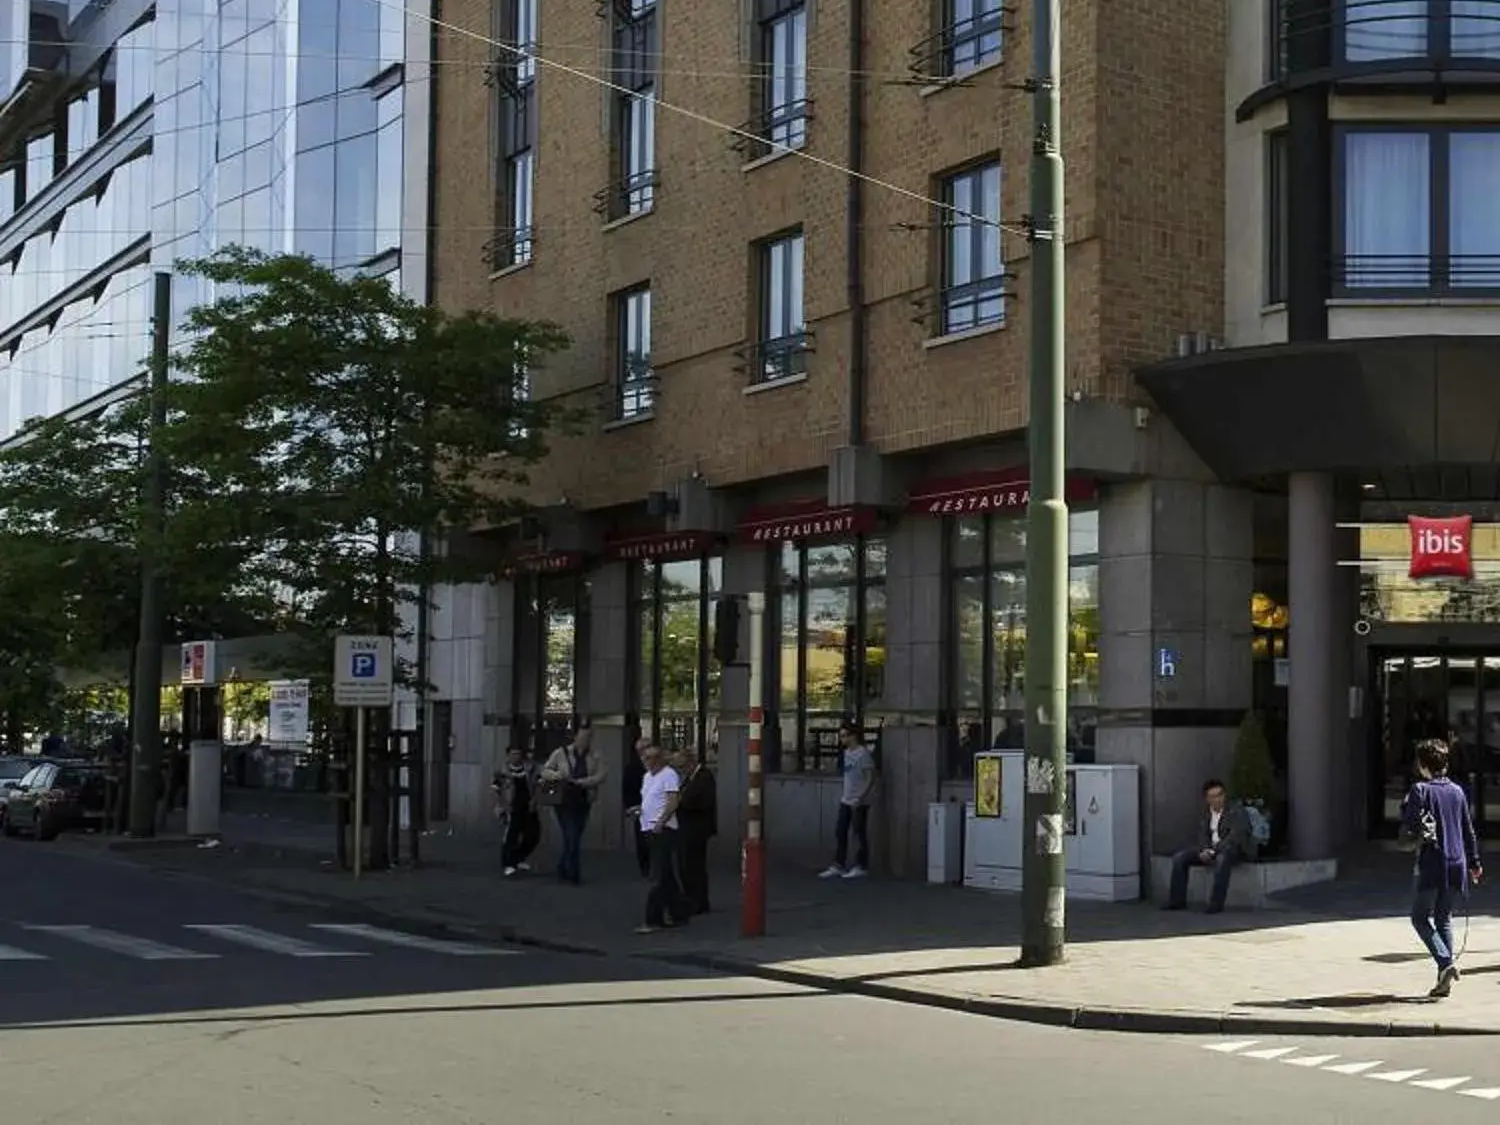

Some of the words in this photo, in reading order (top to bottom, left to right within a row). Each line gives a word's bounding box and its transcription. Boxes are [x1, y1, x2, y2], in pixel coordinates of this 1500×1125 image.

[928, 490, 1032, 513] RESTAURA
[753, 515, 854, 540] RESTAURANT
[1418, 528, 1464, 554] ibis
[356, 656, 372, 674] P
